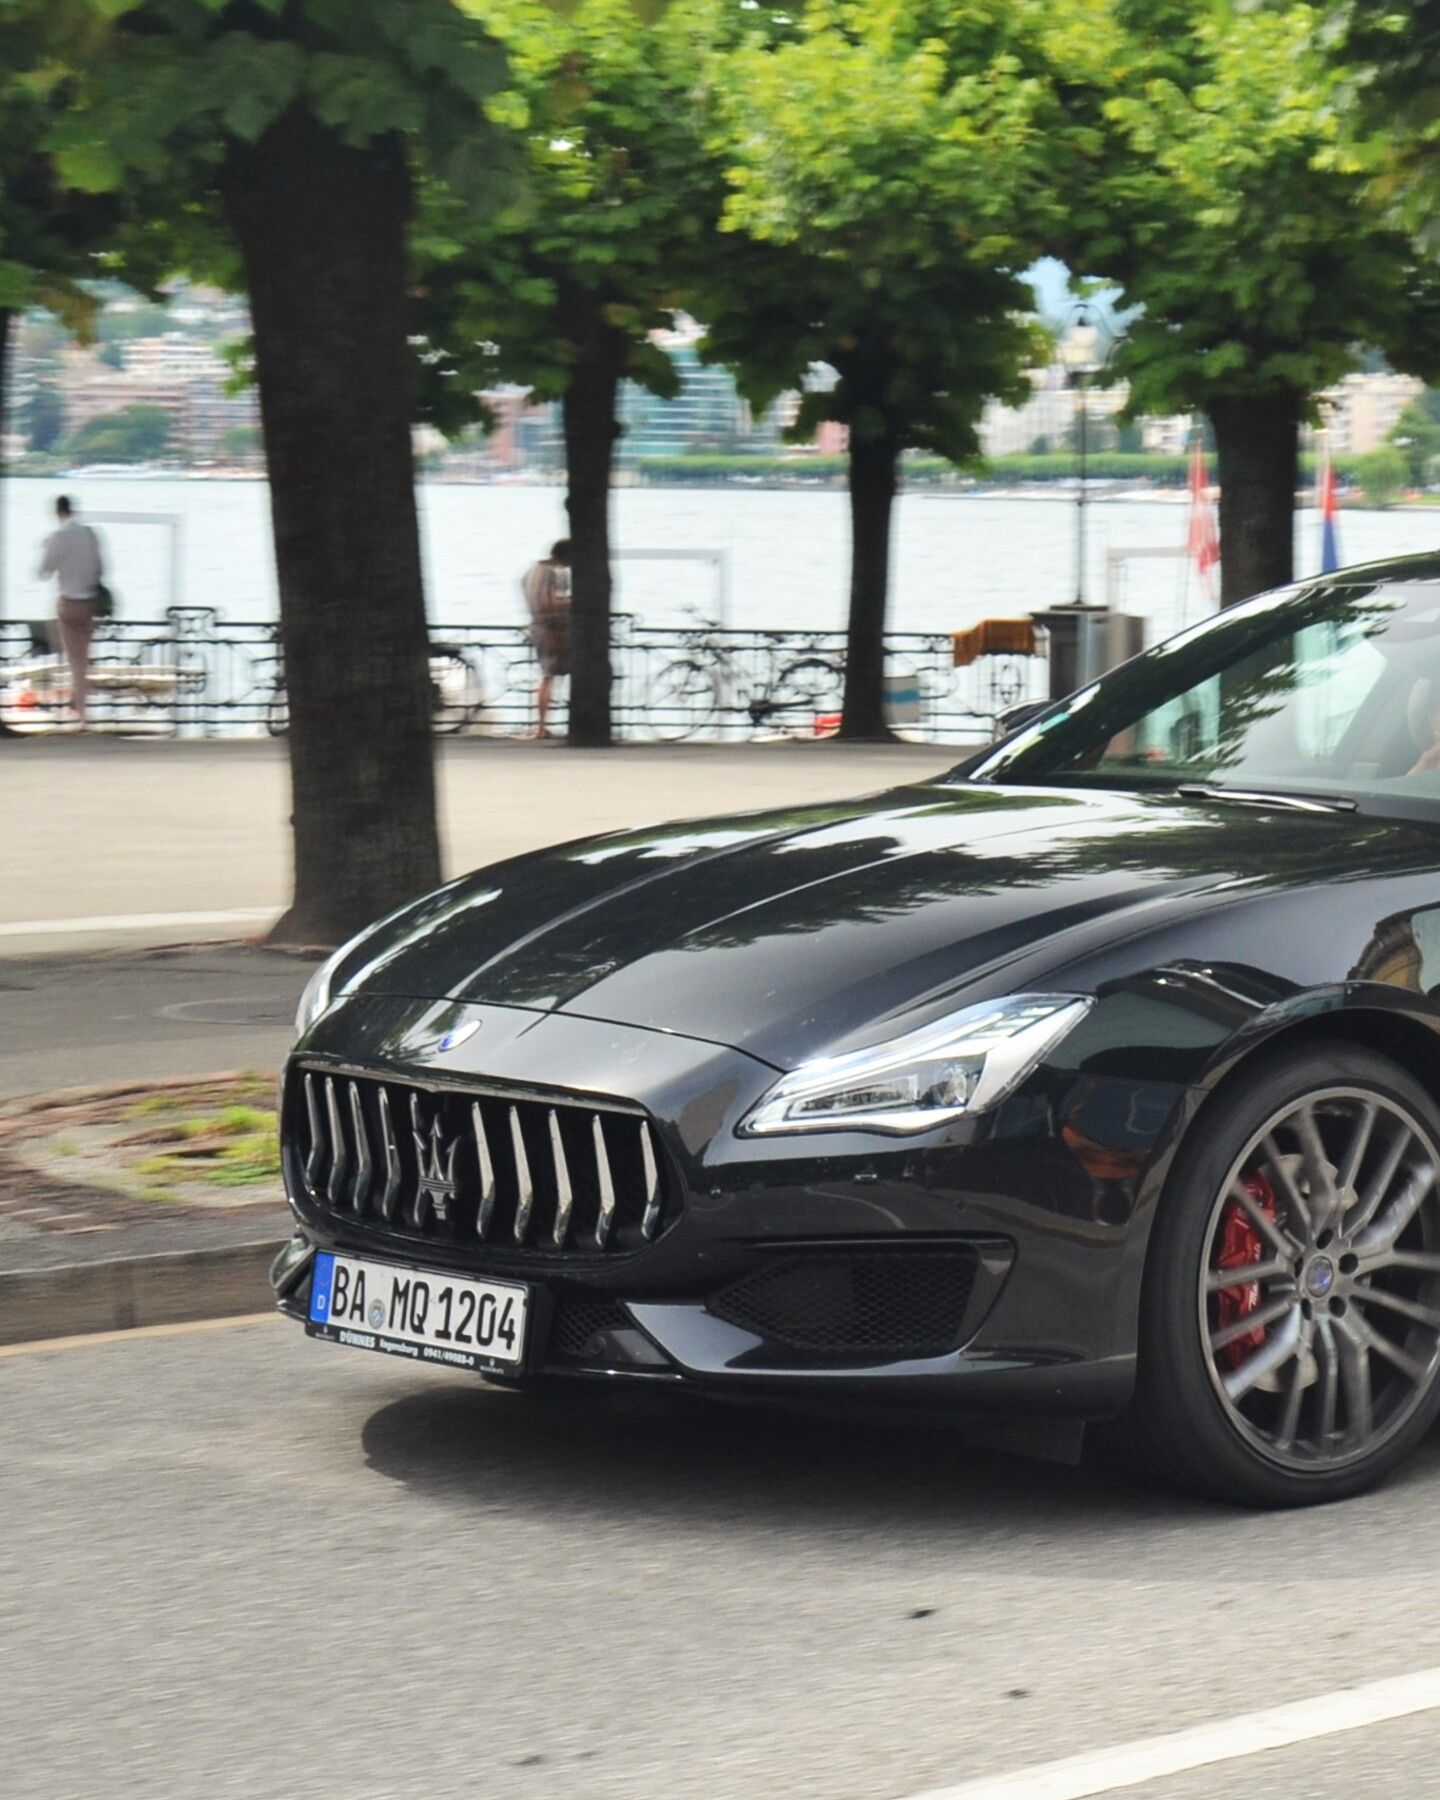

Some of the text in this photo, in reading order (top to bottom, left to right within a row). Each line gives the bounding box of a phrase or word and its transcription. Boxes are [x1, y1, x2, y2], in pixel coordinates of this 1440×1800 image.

[317, 1295, 324, 1310] D
[331, 1265, 516, 1350] BA MQ 1204
